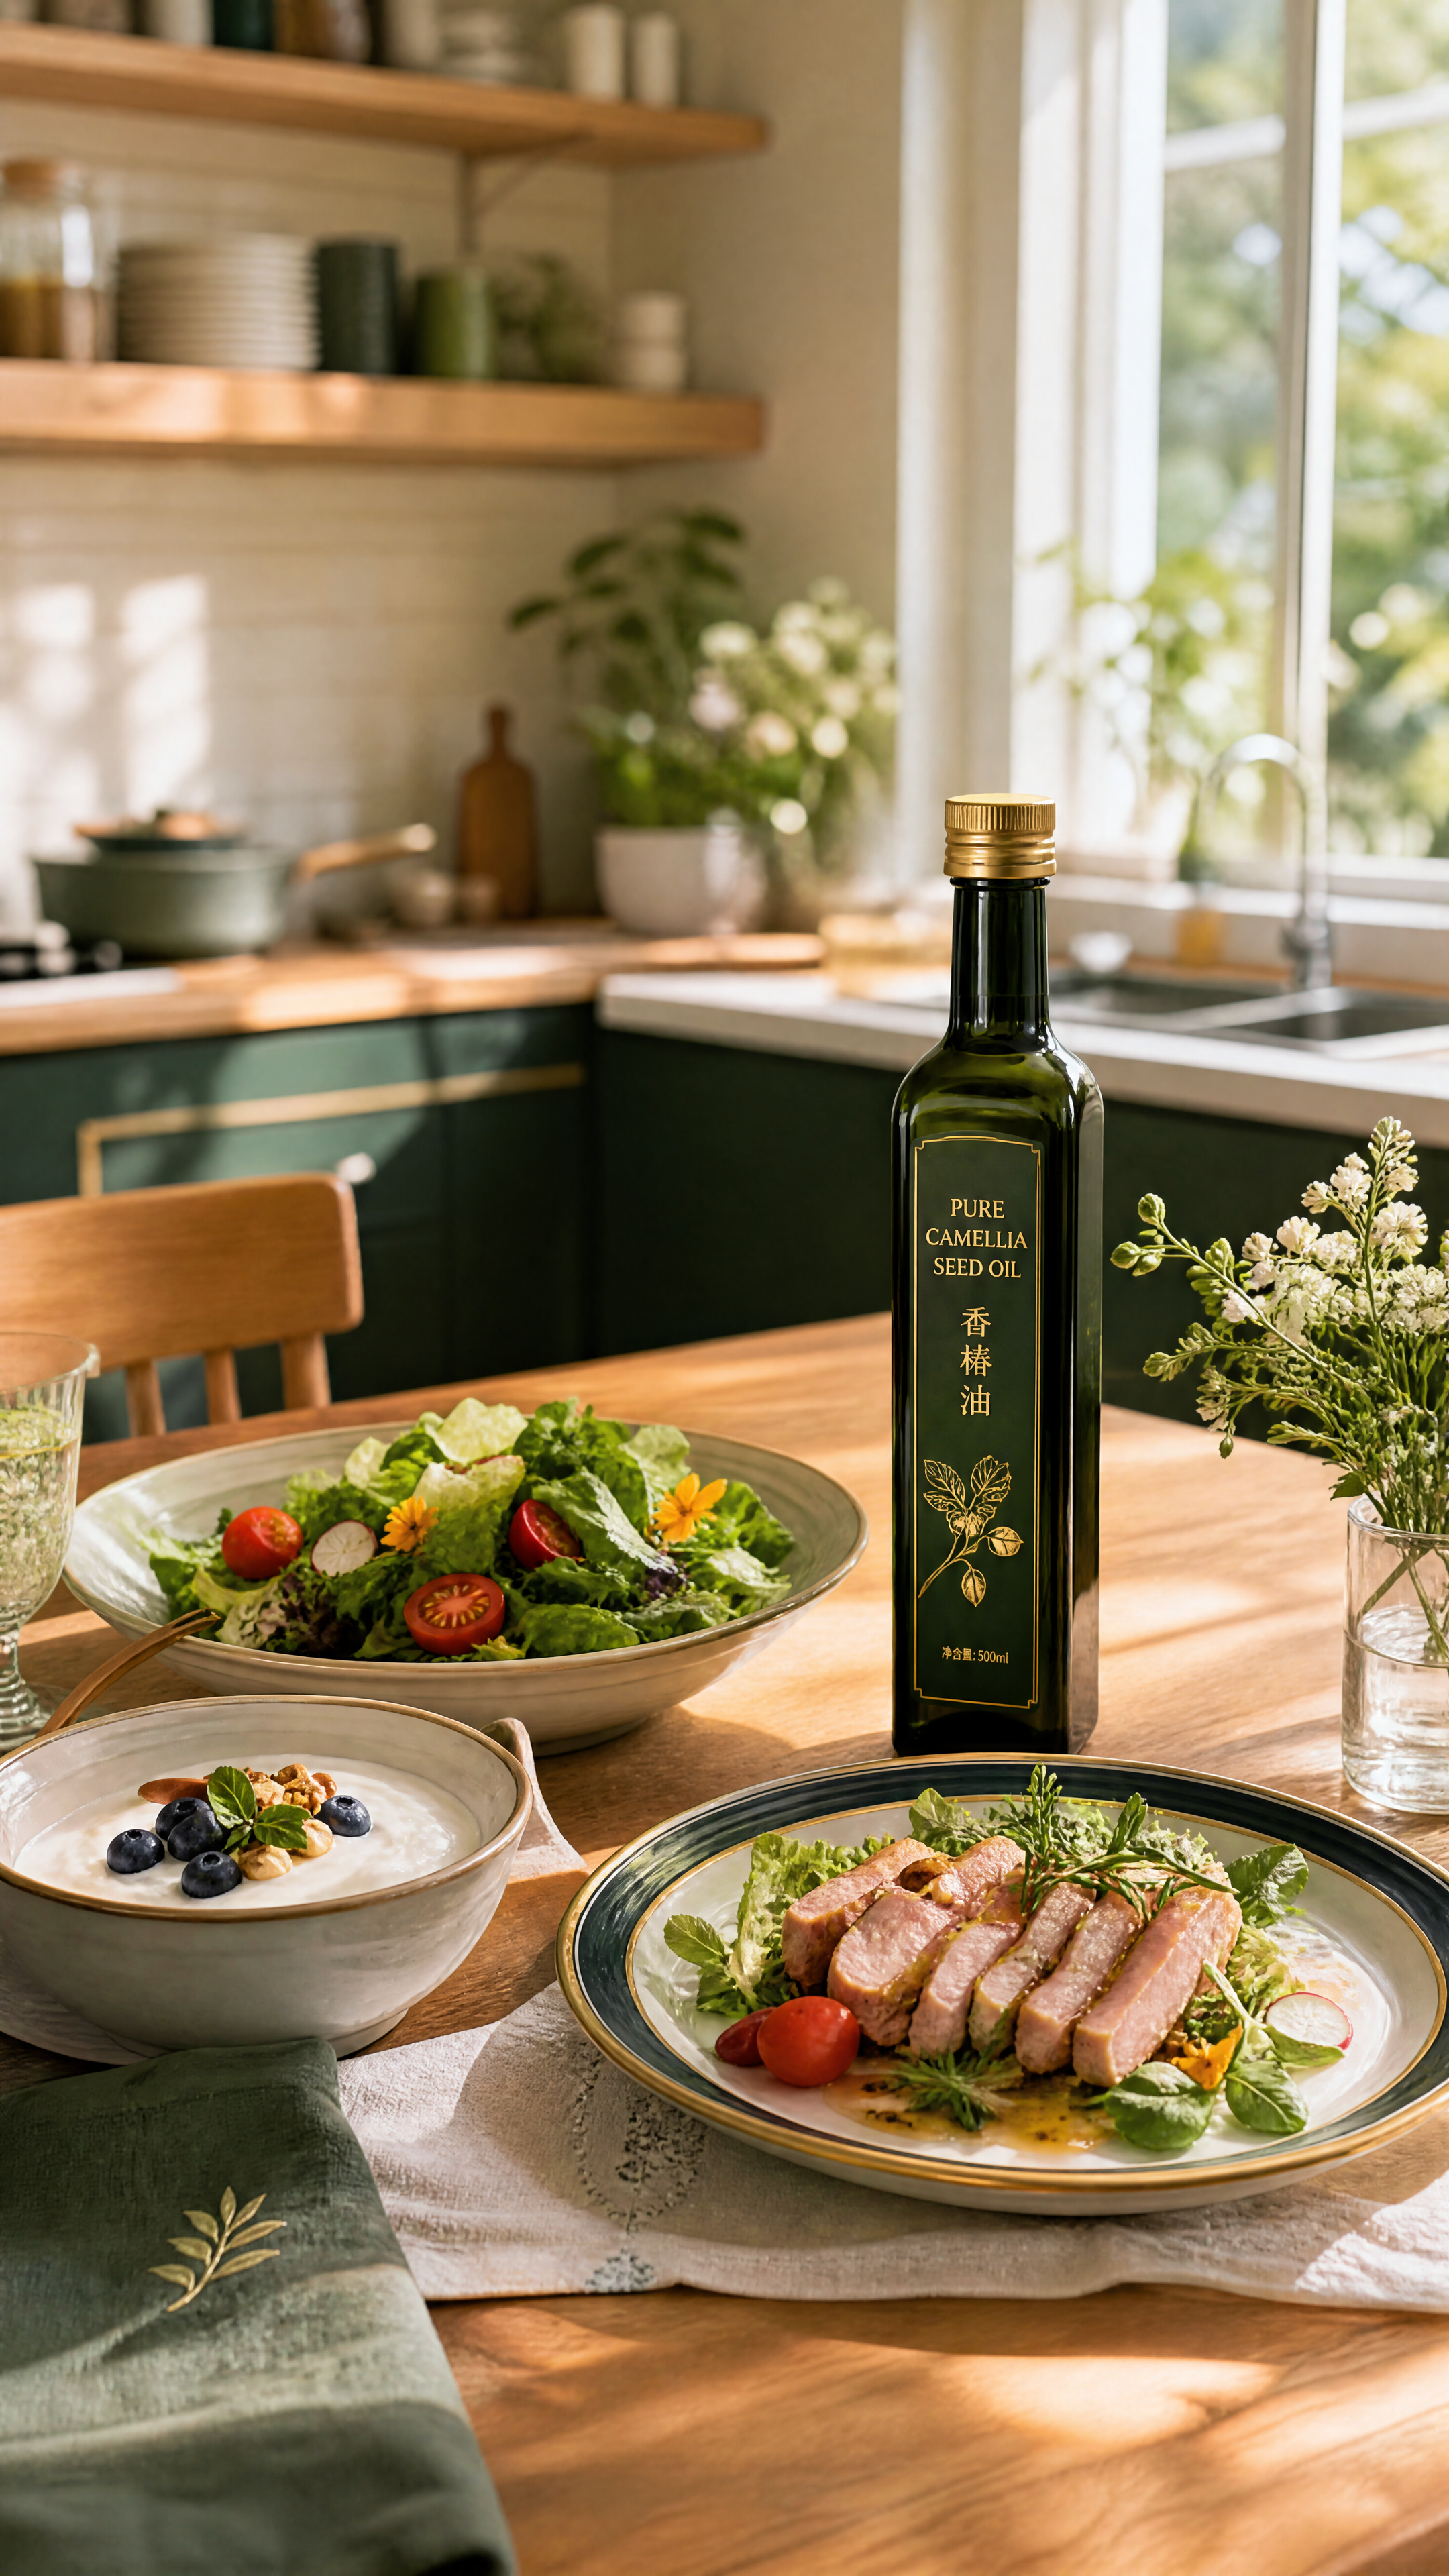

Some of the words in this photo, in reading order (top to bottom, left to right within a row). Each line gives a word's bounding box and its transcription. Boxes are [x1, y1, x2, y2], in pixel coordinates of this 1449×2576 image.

[950, 1198, 1005, 1219] PURE
[926, 1228, 1028, 1249] CAMELLIA
[933, 1257, 983, 1277] SEED
[989, 1259, 1022, 1279] OIL
[959, 1306, 993, 1417] 香椿油
